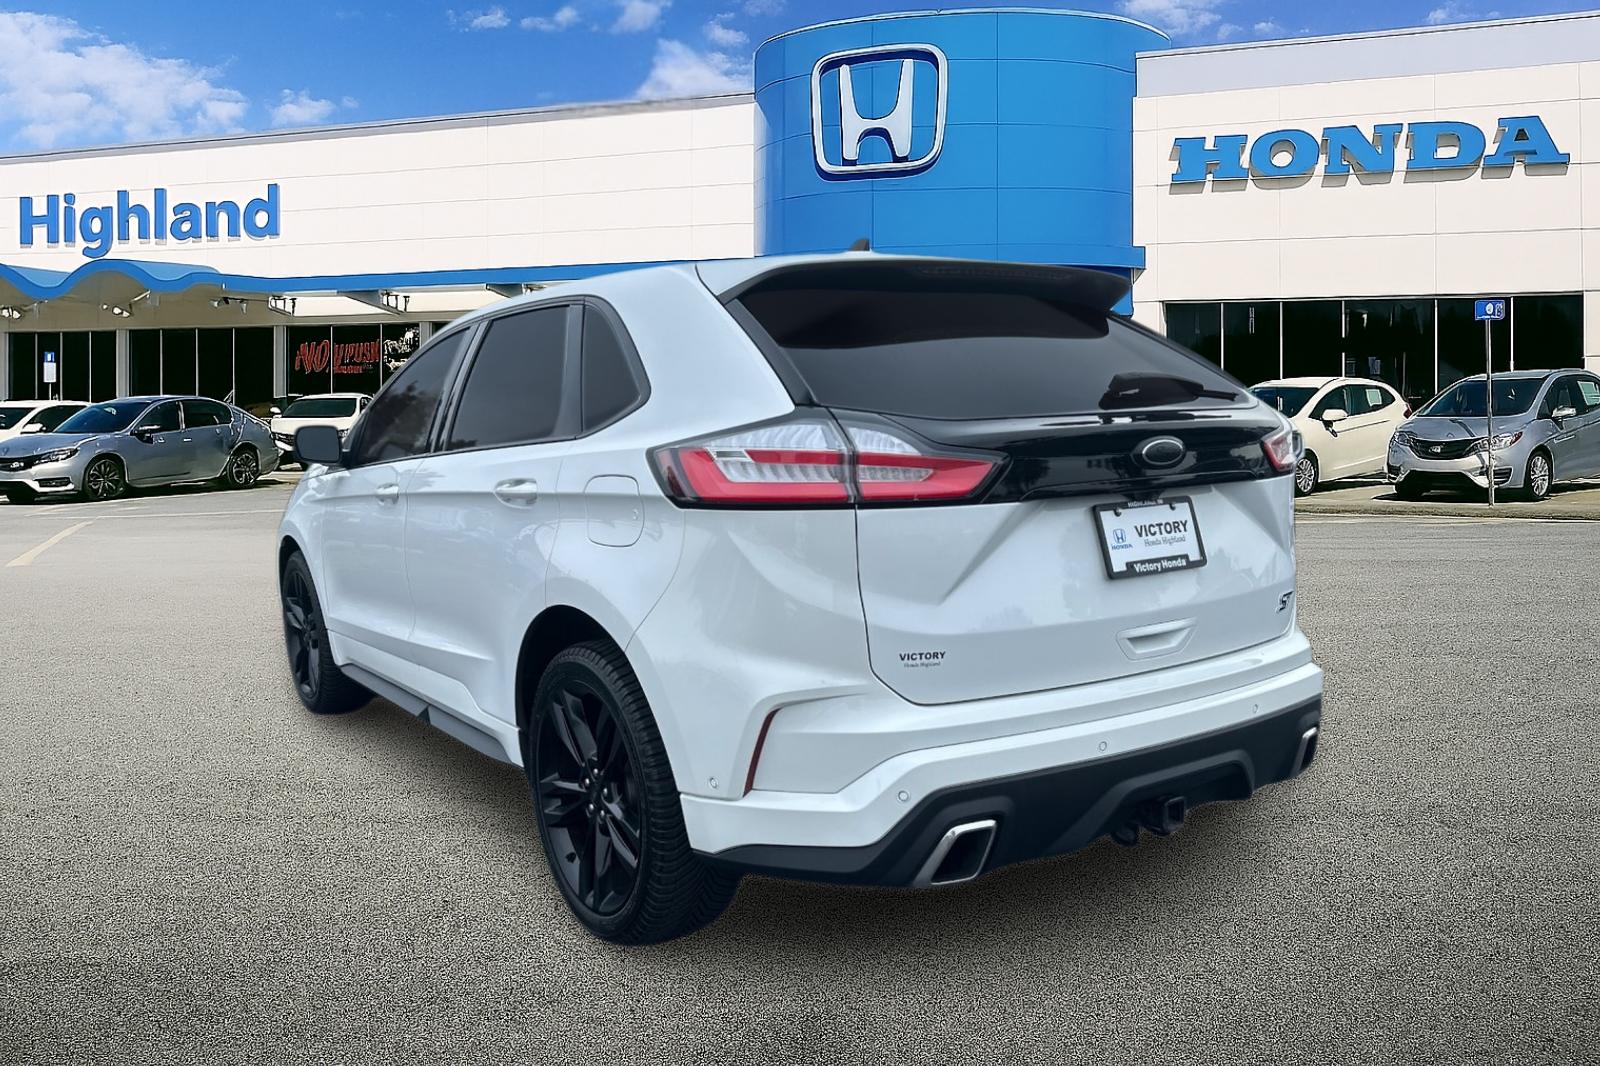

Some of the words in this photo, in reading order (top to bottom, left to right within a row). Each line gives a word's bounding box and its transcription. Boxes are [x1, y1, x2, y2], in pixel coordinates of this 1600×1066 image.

[1171, 115, 1571, 184] HONDA
[19, 183, 281, 258] Highland
[1134, 520, 1188, 538] VICTORY
[1144, 538, 1162, 548] Honda
[1162, 535, 1186, 547] Highland
[1133, 562, 1161, 573] Victory
[1161, 558, 1187, 569] Honda
[899, 651, 946, 661] VICTORY
